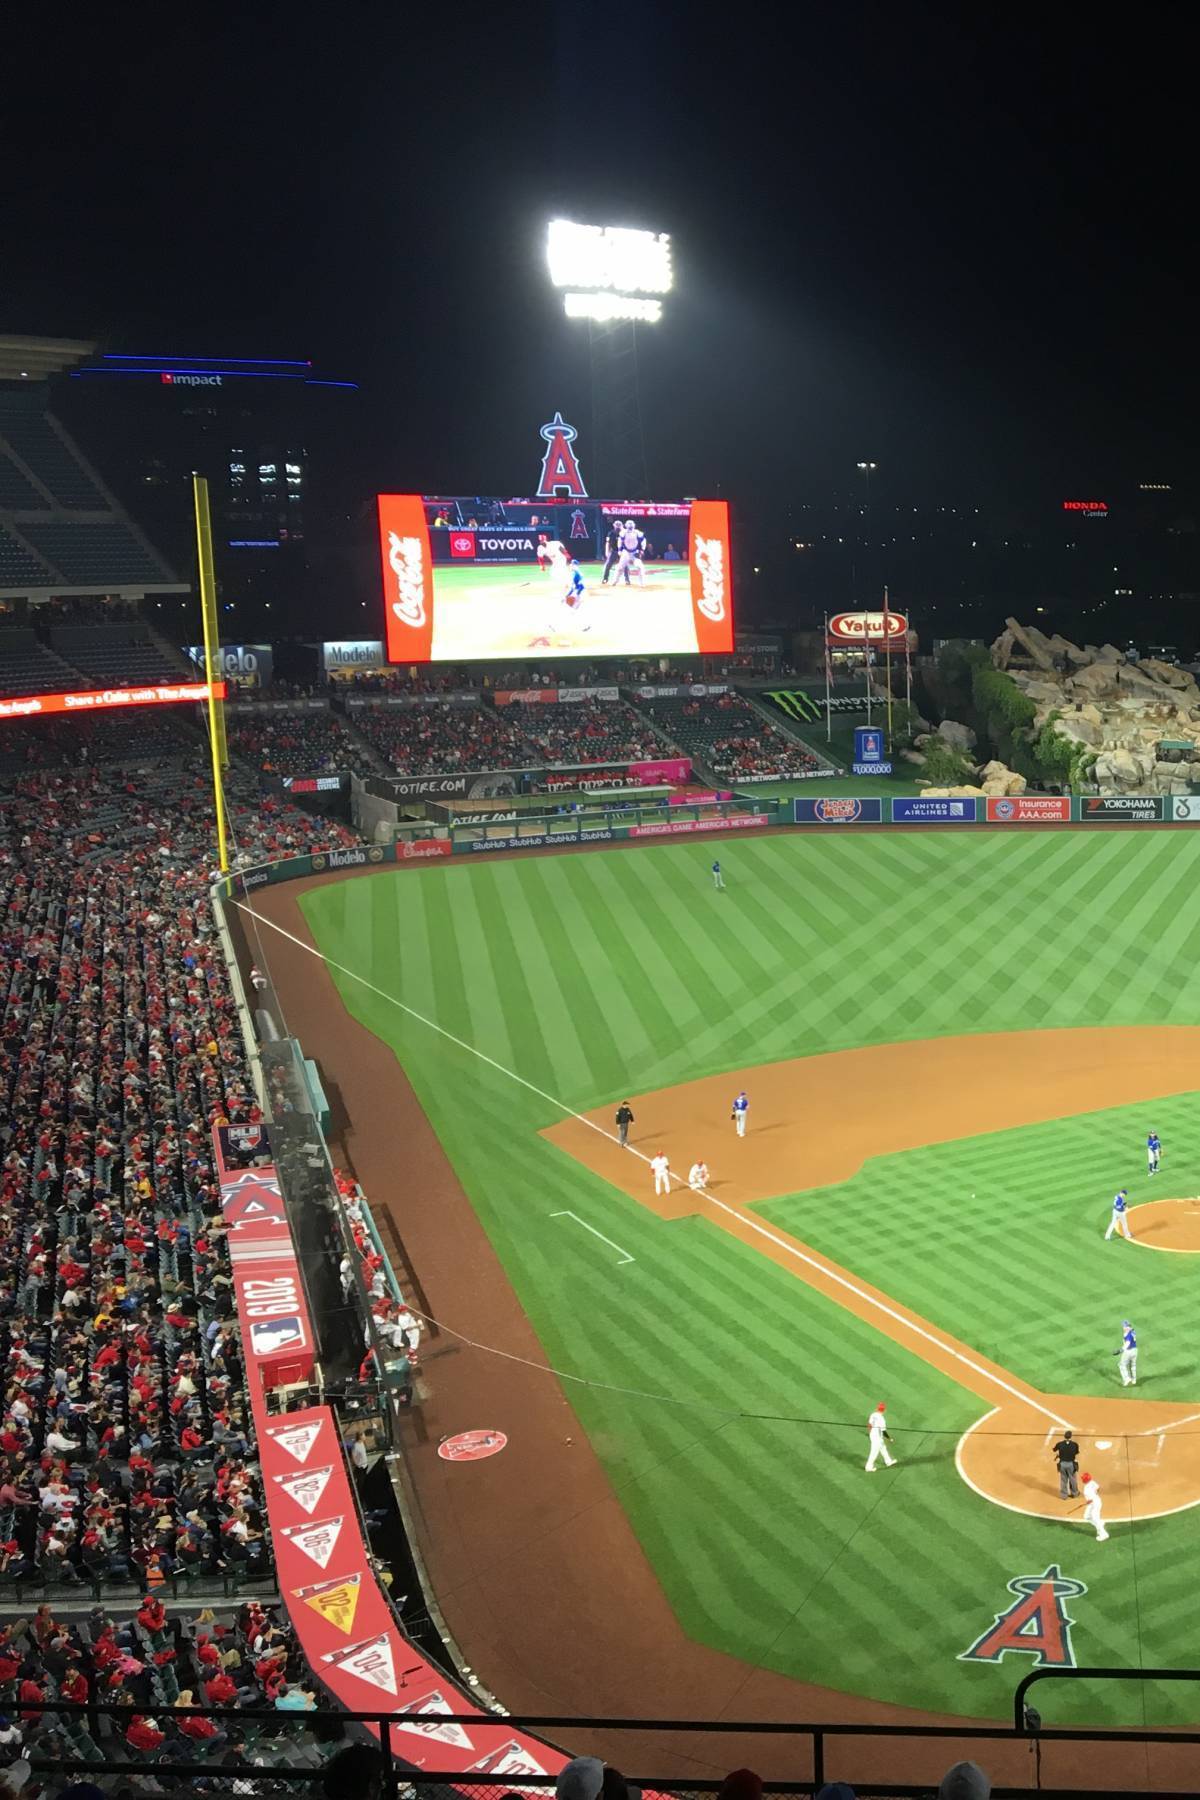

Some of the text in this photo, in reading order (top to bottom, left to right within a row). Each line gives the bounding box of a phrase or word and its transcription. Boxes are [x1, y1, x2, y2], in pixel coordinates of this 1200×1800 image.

[173, 374, 222, 386] impact
[1064, 502, 1107, 510] HONDA
[479, 539, 534, 551] TOYOTA
[330, 647, 375, 662] Modelo
[65, 695, 94, 706] Share
[96, 696, 103, 704] a
[132, 690, 155, 700] with
[157, 689, 177, 699] The
[752, 774, 781, 782] NETWORK
[805, 770, 835, 778] NETWORK
[1019, 800, 1062, 808] Insurance
[1104, 800, 1156, 809] YOKOHAMA
[1019, 810, 1062, 819] AAA.com
[1132, 811, 1156, 819] TIRES
[673, 823, 693, 833] GAME
[473, 831, 611, 850] StubHub StubHub StubHub StubHub
[329, 851, 366, 867] Modelo
[242, 1276, 301, 1317] 2019
[353, 1650, 387, 1674] '04
